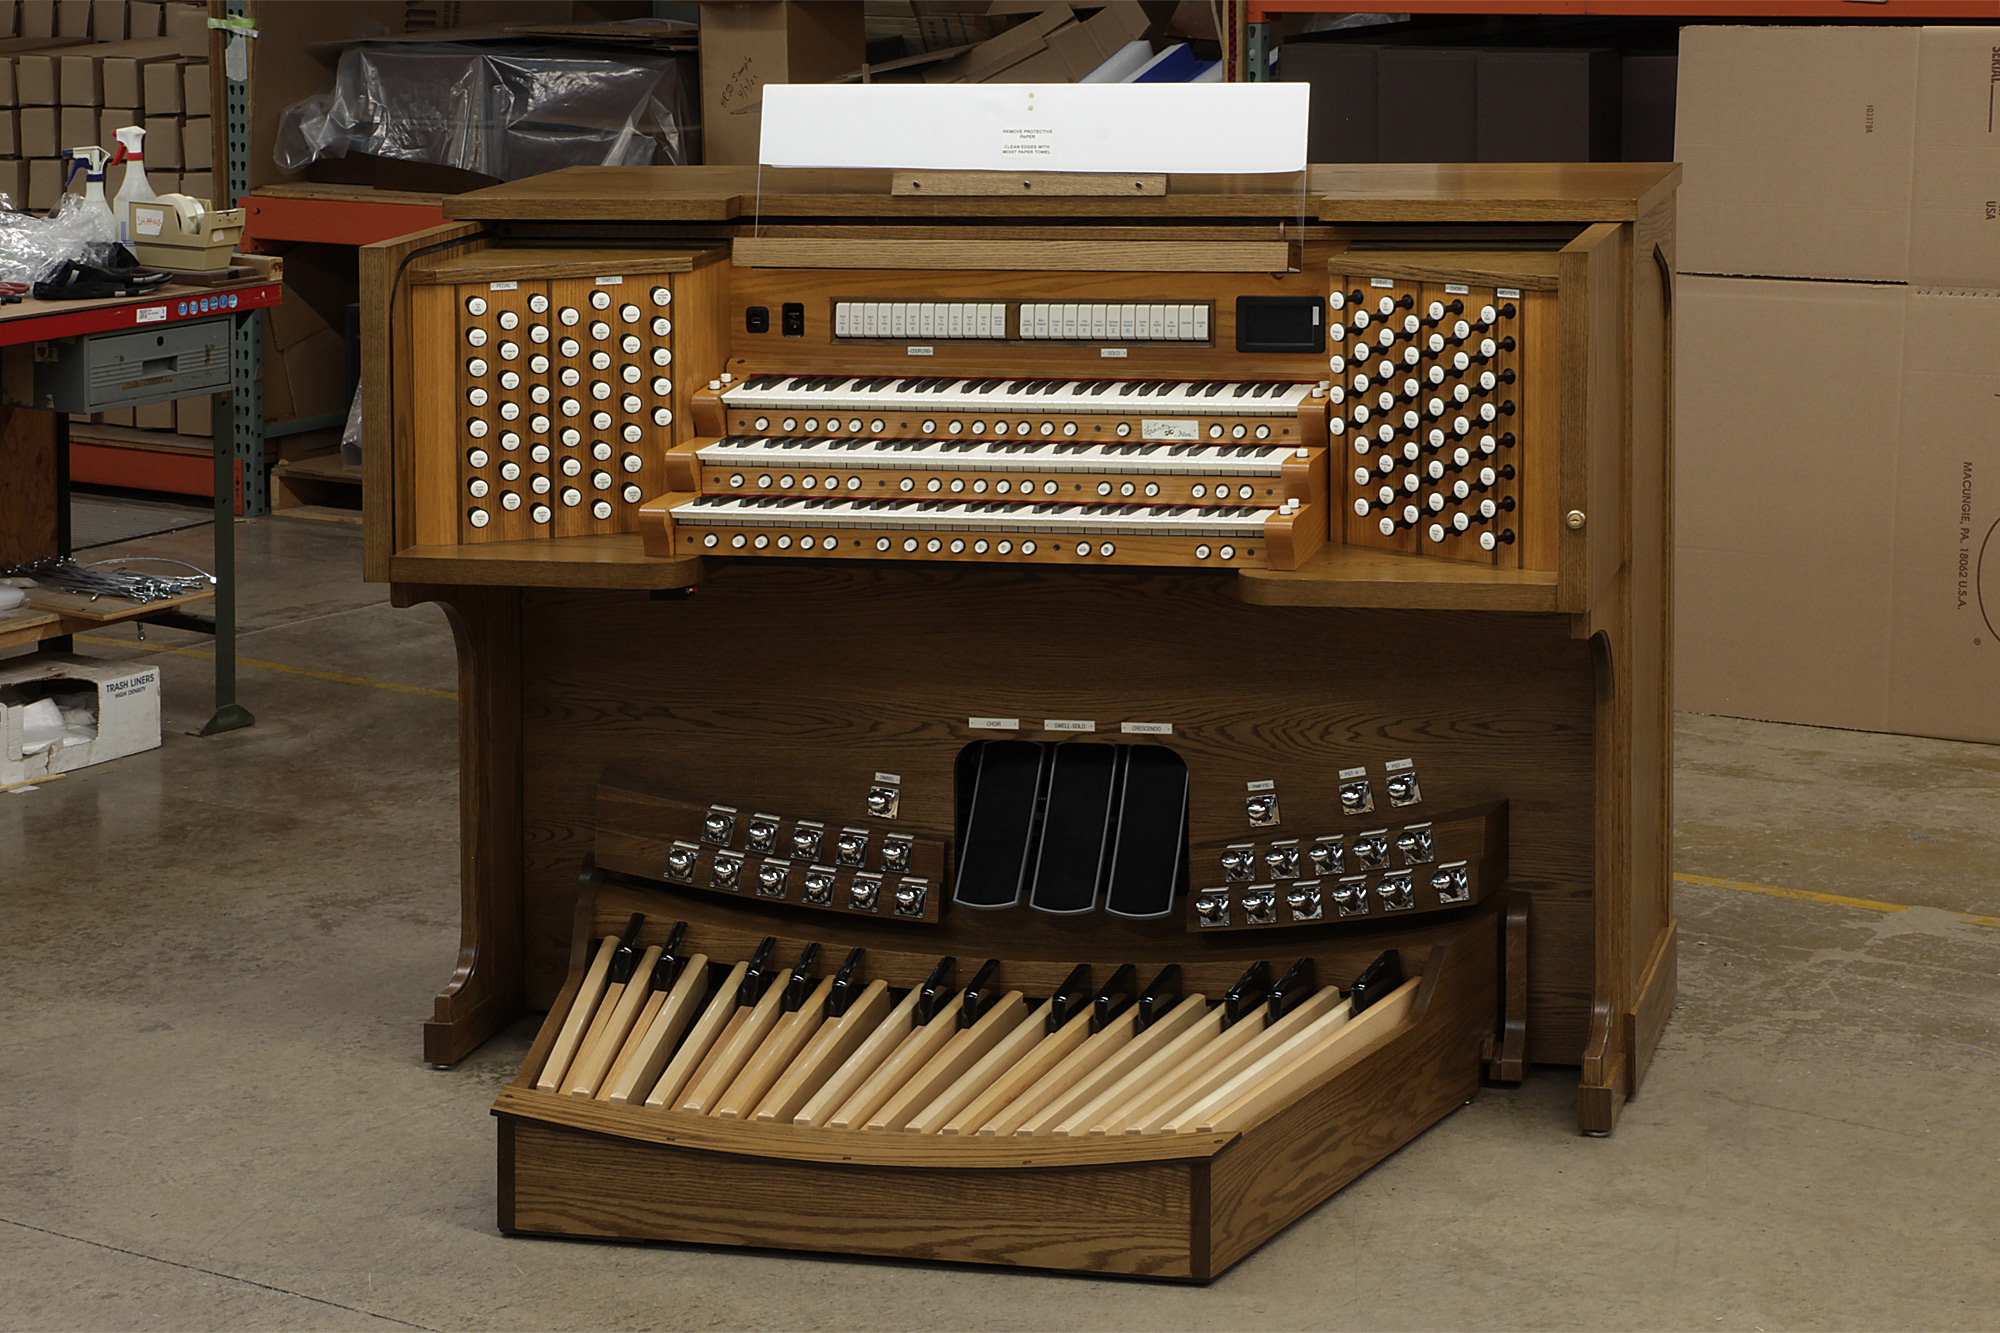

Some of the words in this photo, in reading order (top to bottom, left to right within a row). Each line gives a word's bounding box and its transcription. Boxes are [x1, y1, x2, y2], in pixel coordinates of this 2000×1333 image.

[1986, 201, 1996, 220] USA
[1959, 461, 1973, 525] MACUNGIE,
[1959, 527, 1970, 544] PA.
[1959, 548, 1969, 578] 18062
[1957, 580, 1967, 611] U.S.A.
[106, 680, 129, 693] TRASH
[130, 673, 155, 687] LINERS
[114, 691, 127, 699] HIGH
[128, 686, 146, 696] DENSITY
